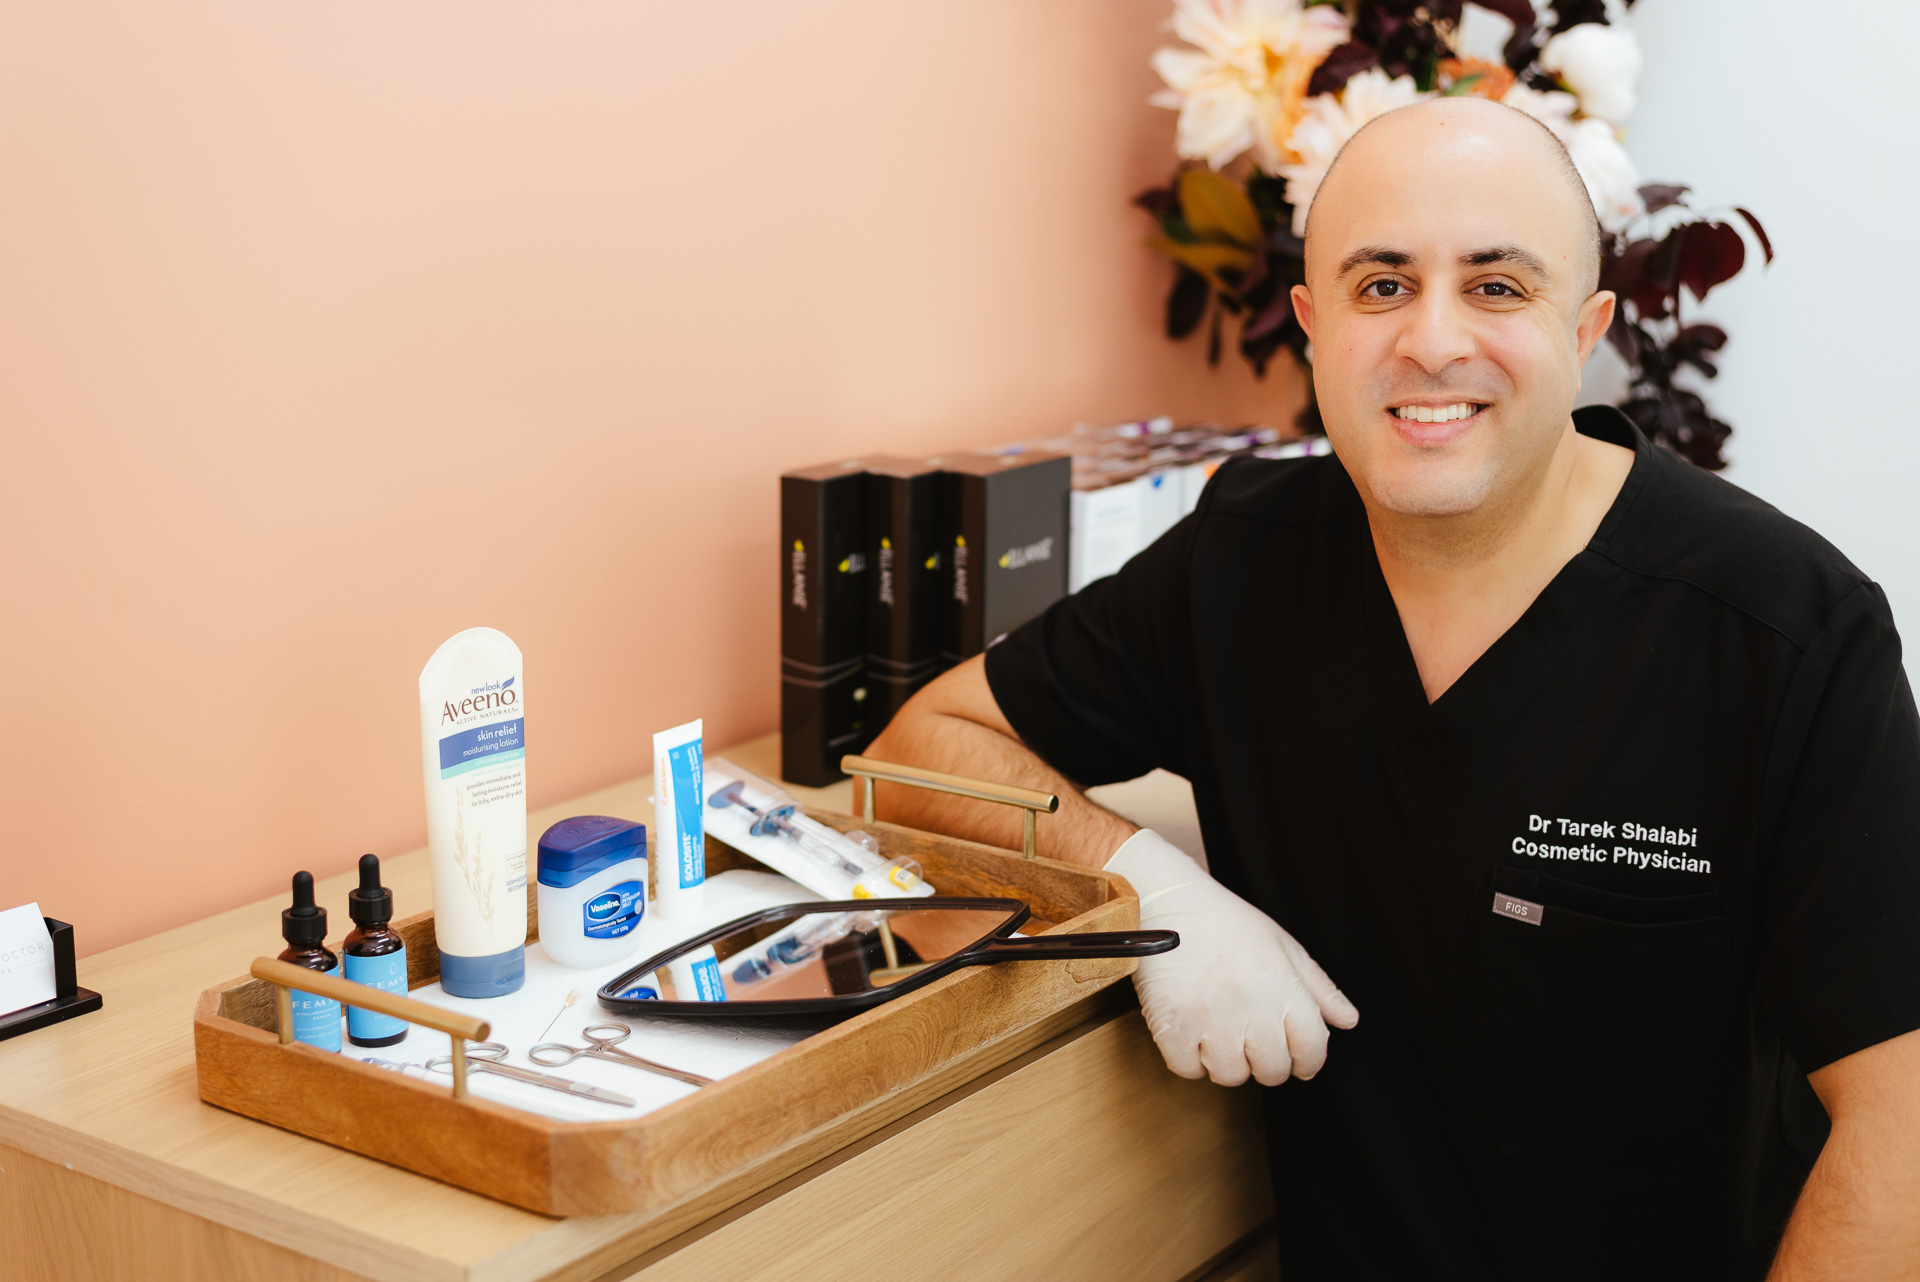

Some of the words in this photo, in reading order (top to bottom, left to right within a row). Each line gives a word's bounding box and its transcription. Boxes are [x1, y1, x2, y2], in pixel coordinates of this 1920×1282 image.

[441, 689, 516, 726] Aveeno
[456, 715, 477, 725] ACTIVE
[477, 728, 494, 741] skin
[495, 723, 517, 737] relief
[463, 742, 498, 756] moisturising
[499, 738, 518, 747] lotion
[466, 781, 485, 791] provides
[486, 775, 511, 784] immediate
[513, 770, 521, 778] and
[488, 785, 509, 793] moisture
[510, 779, 522, 787] relief
[491, 792, 514, 801] extra-dry
[1529, 814, 1551, 833] Dr
[1557, 818, 1616, 839] Tarek
[1621, 822, 1697, 847] Shalabi
[1512, 837, 1608, 863] Cosmetic
[1613, 846, 1711, 874] Physician
[590, 900, 618, 913] Vaseline
[1505, 901, 1528, 916] FIGS
